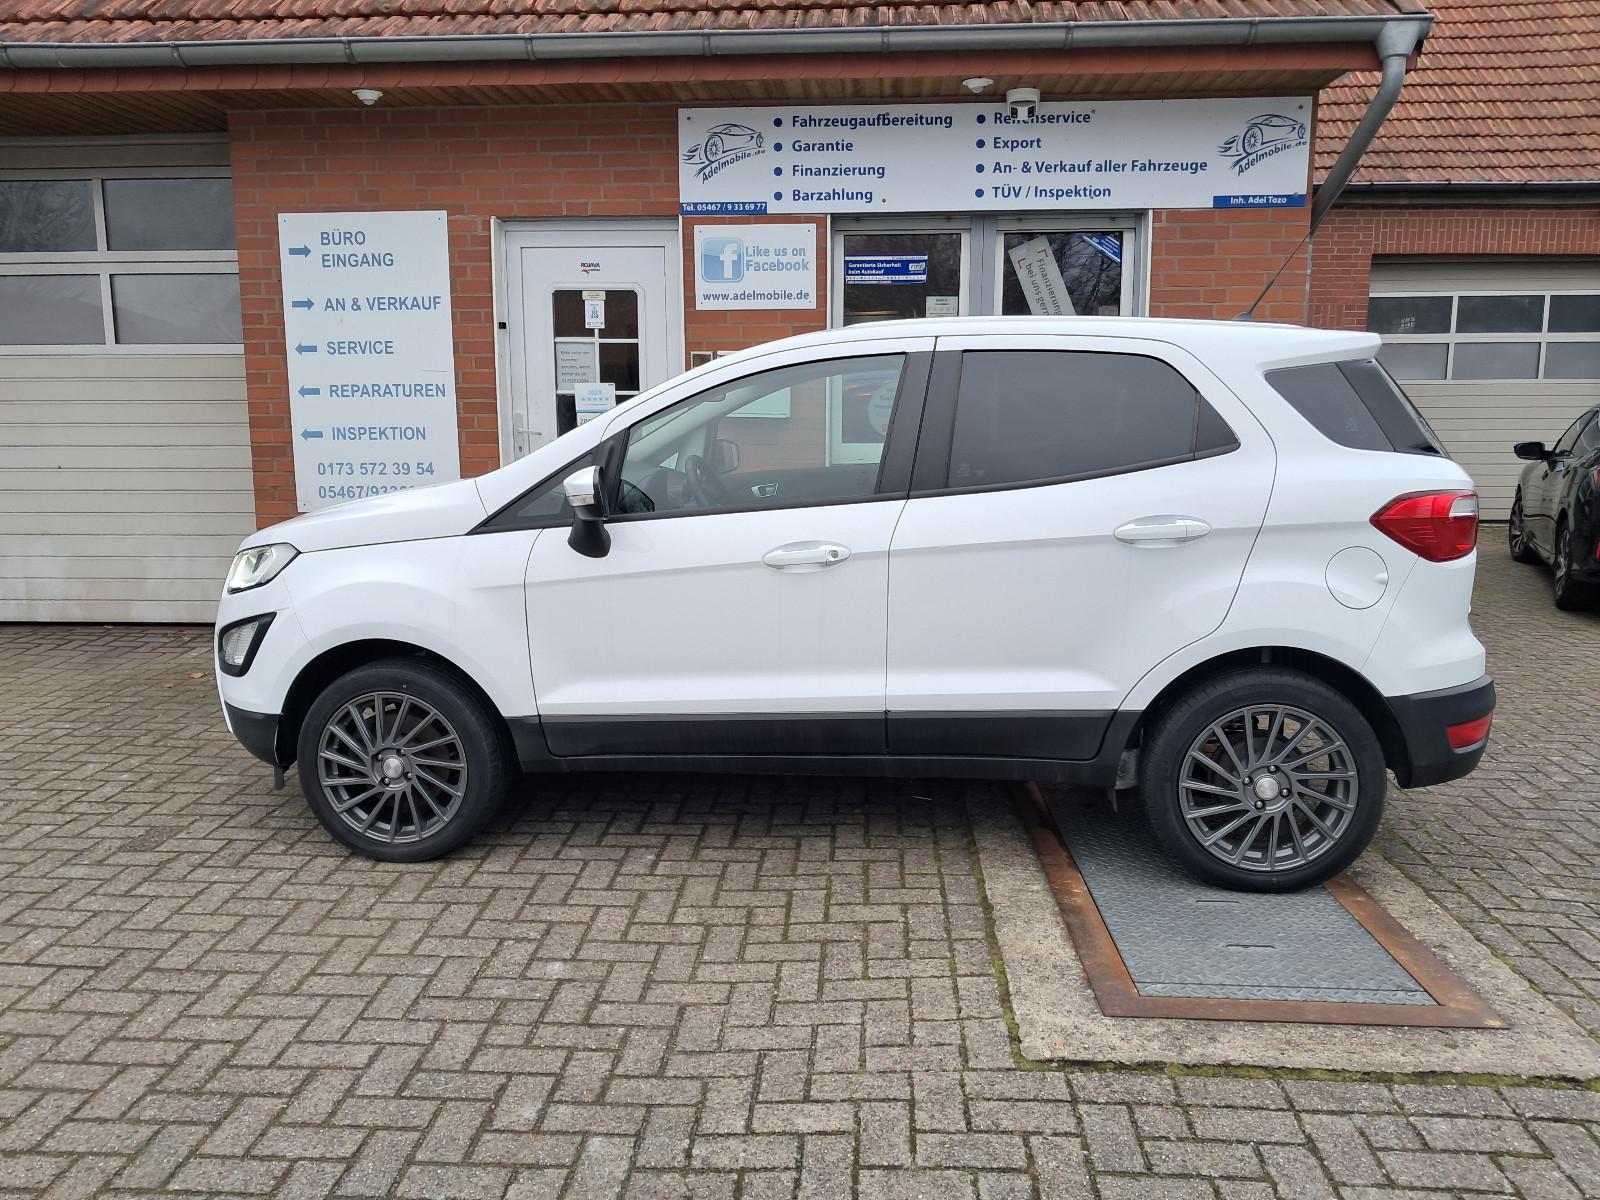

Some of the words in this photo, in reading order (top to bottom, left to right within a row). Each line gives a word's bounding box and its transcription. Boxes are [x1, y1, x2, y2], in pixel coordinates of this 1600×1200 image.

[792, 113, 953, 130] Fahrzeugaufbereitung
[792, 139, 854, 152] Garantie
[993, 137, 1042, 152] Export
[1237, 141, 1308, 177] Adelmobile.de
[702, 149, 766, 185] Adelmobile.de
[792, 163, 886, 179] Finanzierung
[992, 161, 1017, 174] An-
[1021, 161, 1032, 173] &
[1035, 159, 1093, 173] Verkauf
[1095, 159, 1128, 173] aller
[1131, 159, 1209, 175] Fahrzeuge
[792, 188, 873, 203] Barzahlung
[992, 183, 1022, 199] TÜV
[1025, 185, 1032, 199] /
[1034, 185, 1112, 201] Inspektion
[682, 203, 696, 211] Tel.
[697, 203, 721, 211] 05467
[733, 203, 743, 211] 33
[744, 203, 755, 211] 69
[756, 203, 766, 211] 77
[1230, 196, 1247, 205] Inh.
[1248, 196, 1267, 204] Adel
[1268, 196, 1288, 204] Tozo
[320, 228, 366, 246] BÜRO
[745, 245, 770, 258] Like
[774, 247, 788, 257] us
[792, 247, 806, 257] on
[321, 252, 394, 268] EINGANG
[745, 259, 810, 272] Facebook
[702, 290, 810, 301] www.adelmobile.de
[324, 297, 346, 312] AN
[351, 297, 362, 311] &
[366, 295, 442, 311] VERKAUF
[327, 340, 395, 355] SERVICE
[329, 383, 447, 398] REPARATUREN
[331, 426, 427, 441] INSPEKTION
[317, 461, 355, 476] 0173
[359, 461, 387, 476] 572
[392, 461, 411, 476] 39
[416, 461, 435, 476] 54
